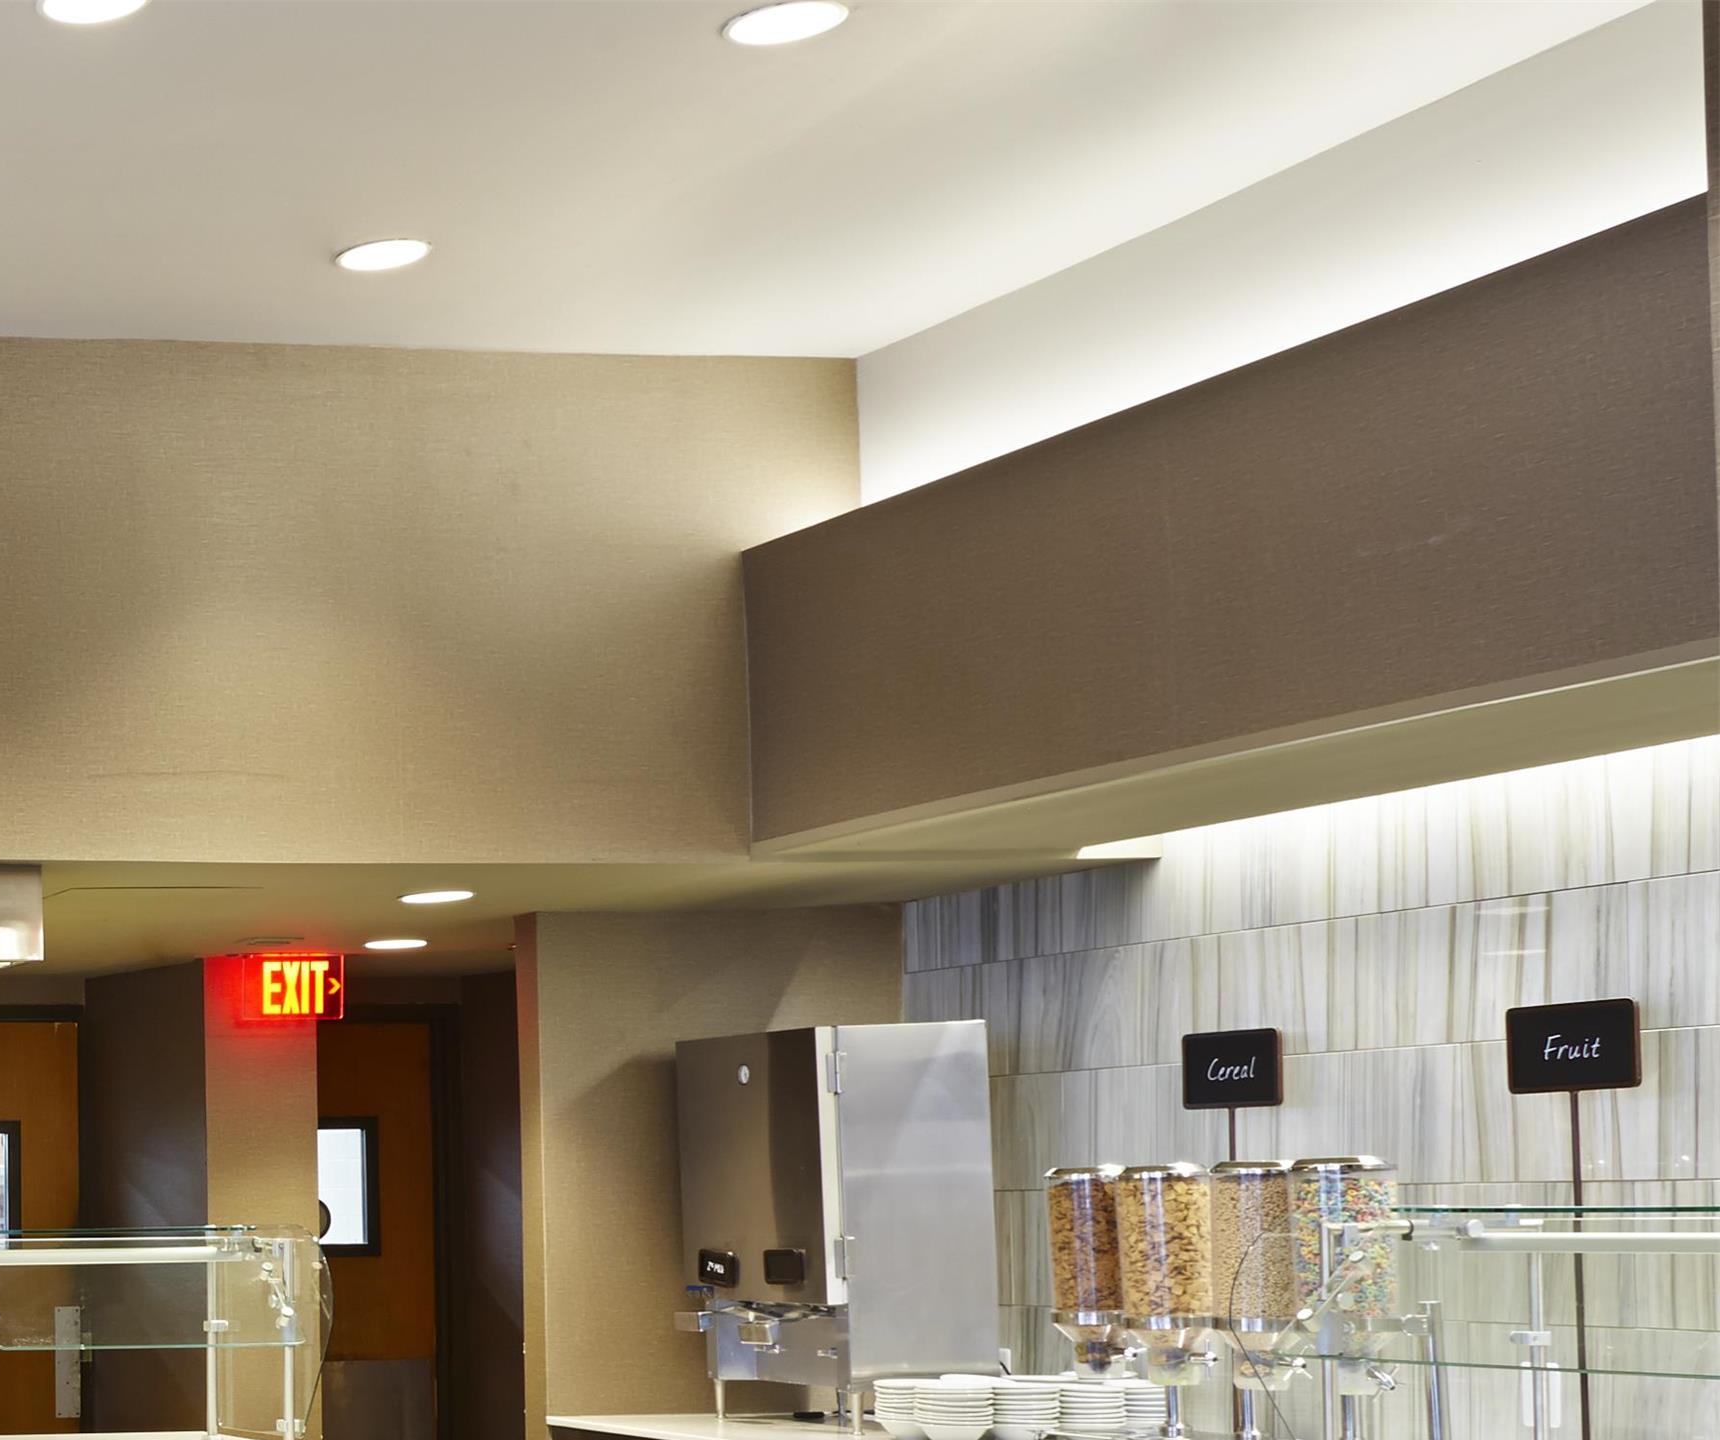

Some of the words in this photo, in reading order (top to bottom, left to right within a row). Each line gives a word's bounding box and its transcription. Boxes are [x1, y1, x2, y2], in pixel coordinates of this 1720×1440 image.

[263, 961, 329, 1014] EXIT
[1544, 1035, 1600, 1060] Fruit
[1208, 1057, 1255, 1080] Cereal
